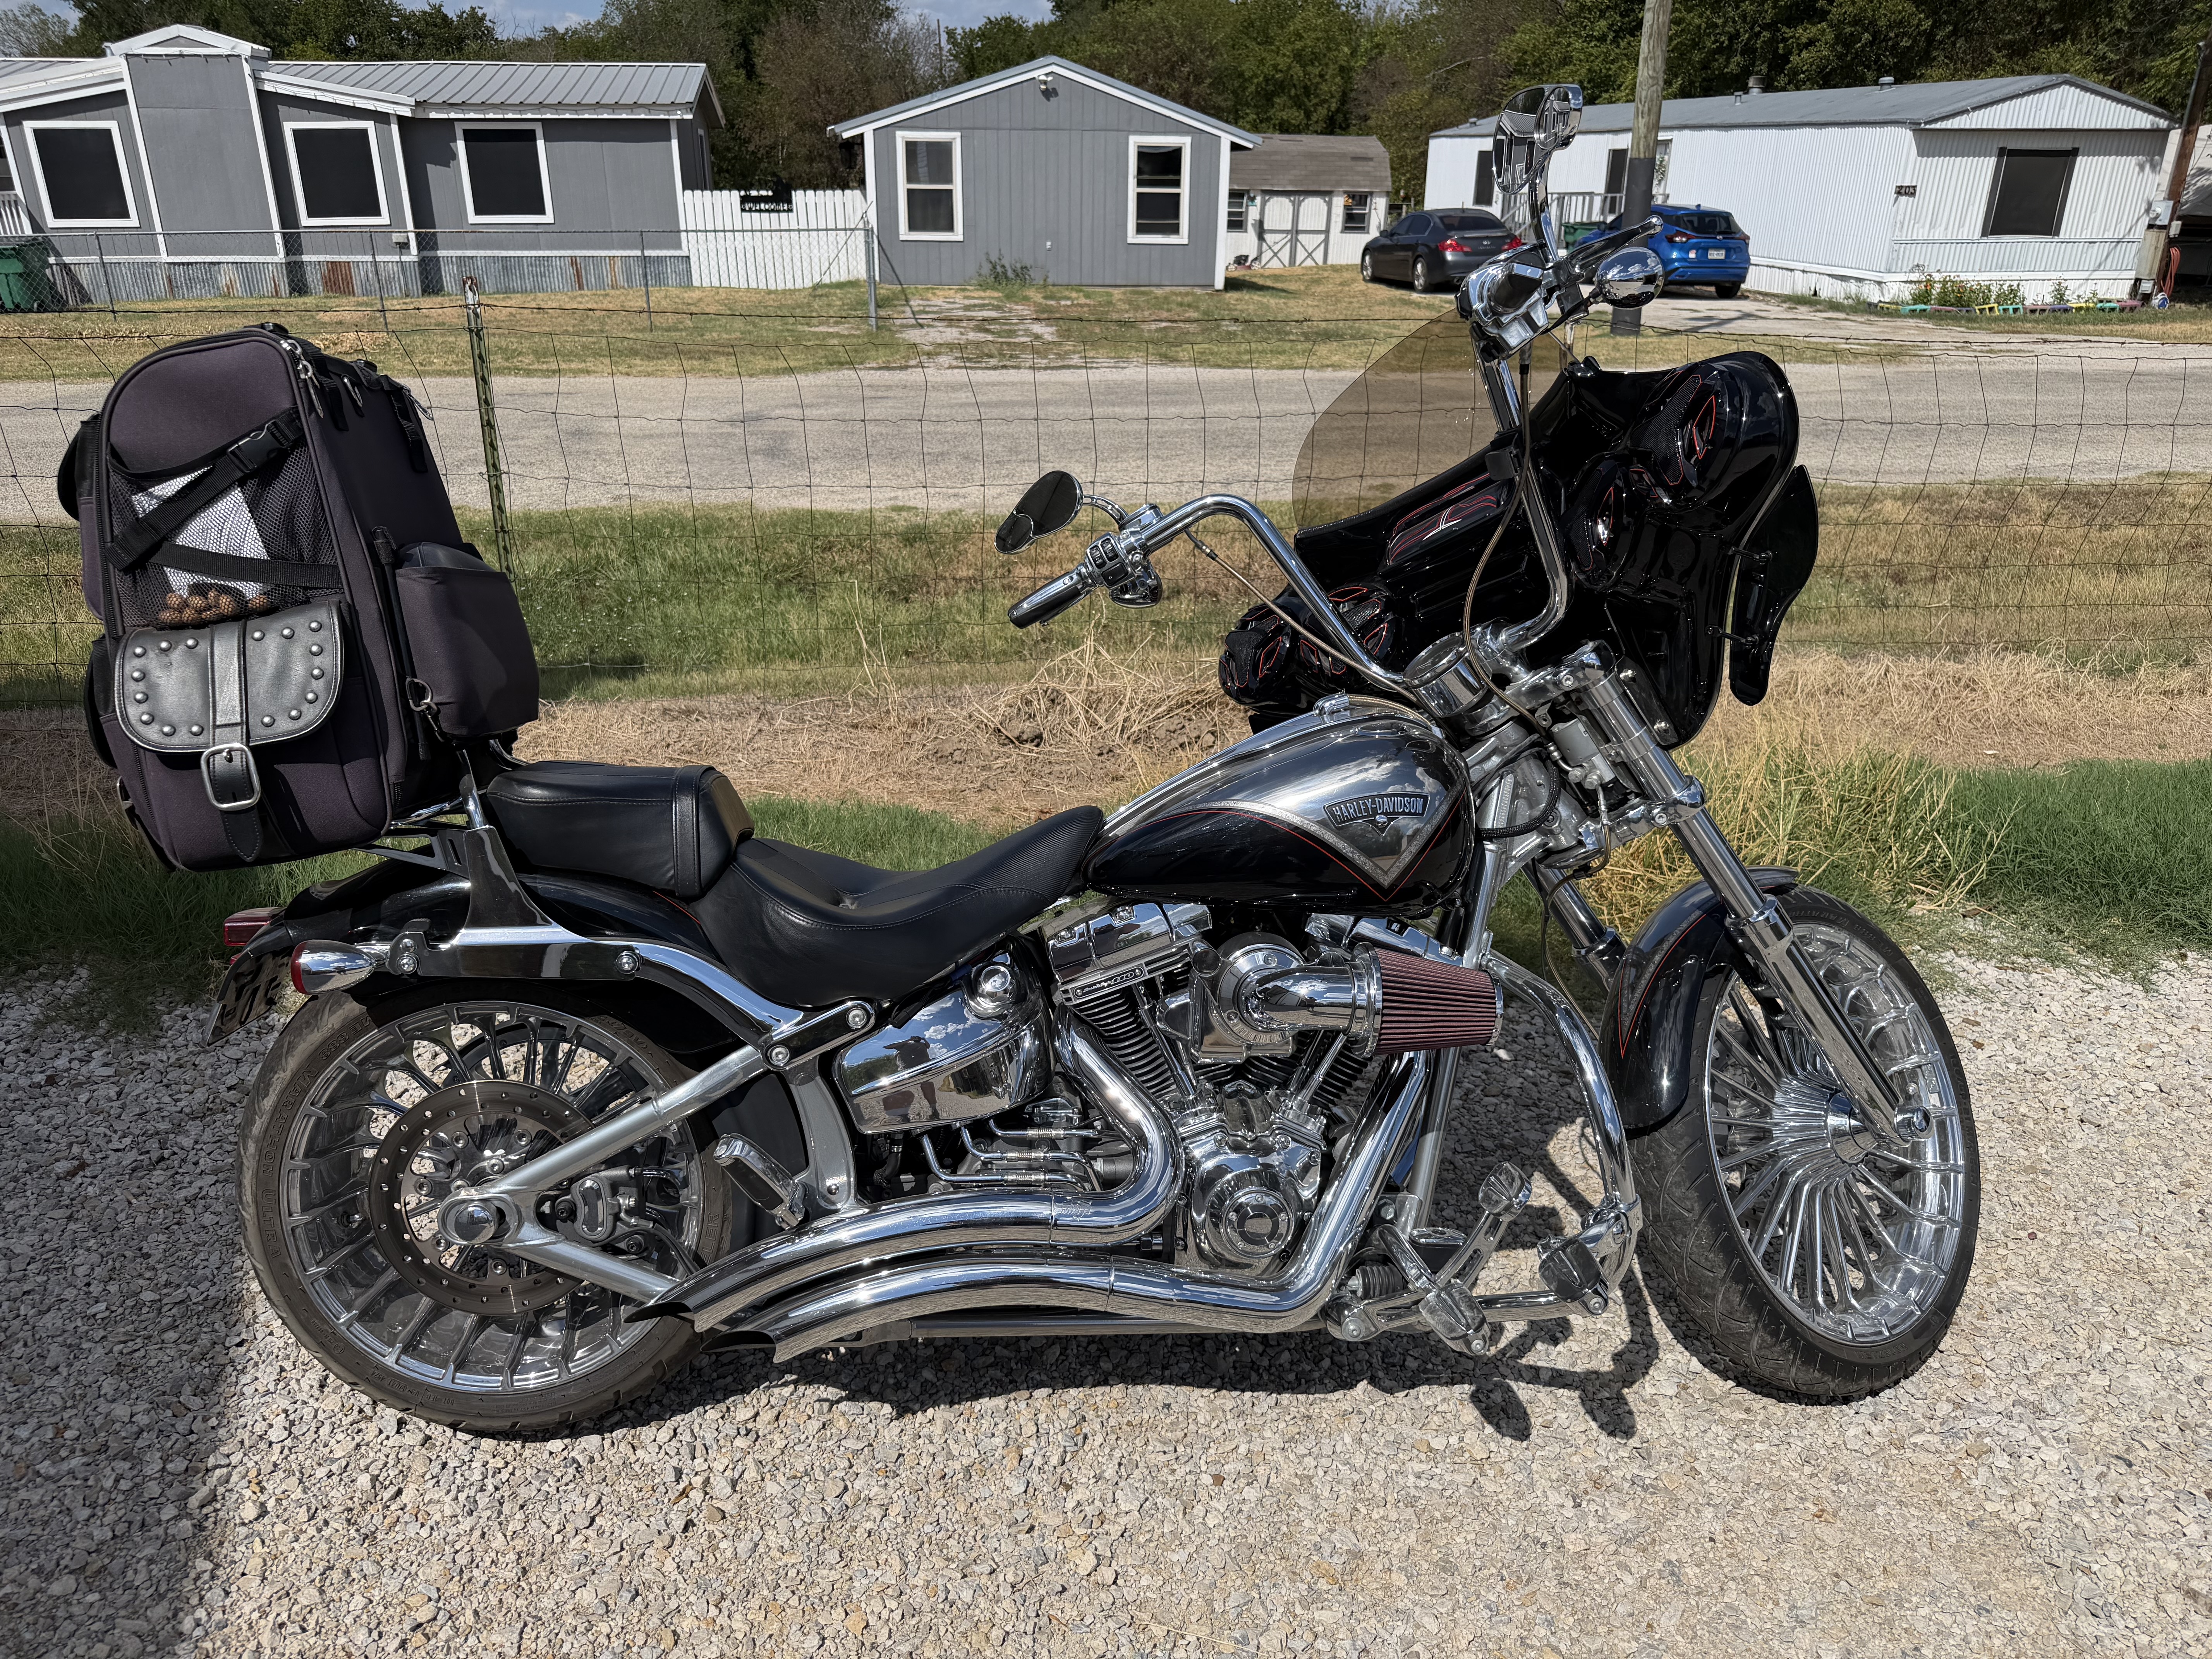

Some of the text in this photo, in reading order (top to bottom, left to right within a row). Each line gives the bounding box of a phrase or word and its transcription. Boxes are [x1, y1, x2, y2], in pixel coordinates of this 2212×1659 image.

[1897, 185, 1916, 195] 203
[1333, 797, 1424, 823] HARLEY-DAVIDSON
[1788, 910, 1850, 927] MARATHO
[318, 1031, 350, 1061] 888
[262, 1063, 319, 1178] MARATHON
[261, 1188, 282, 1258] ULTRA
[1855, 1342, 1908, 1360] METZELER
